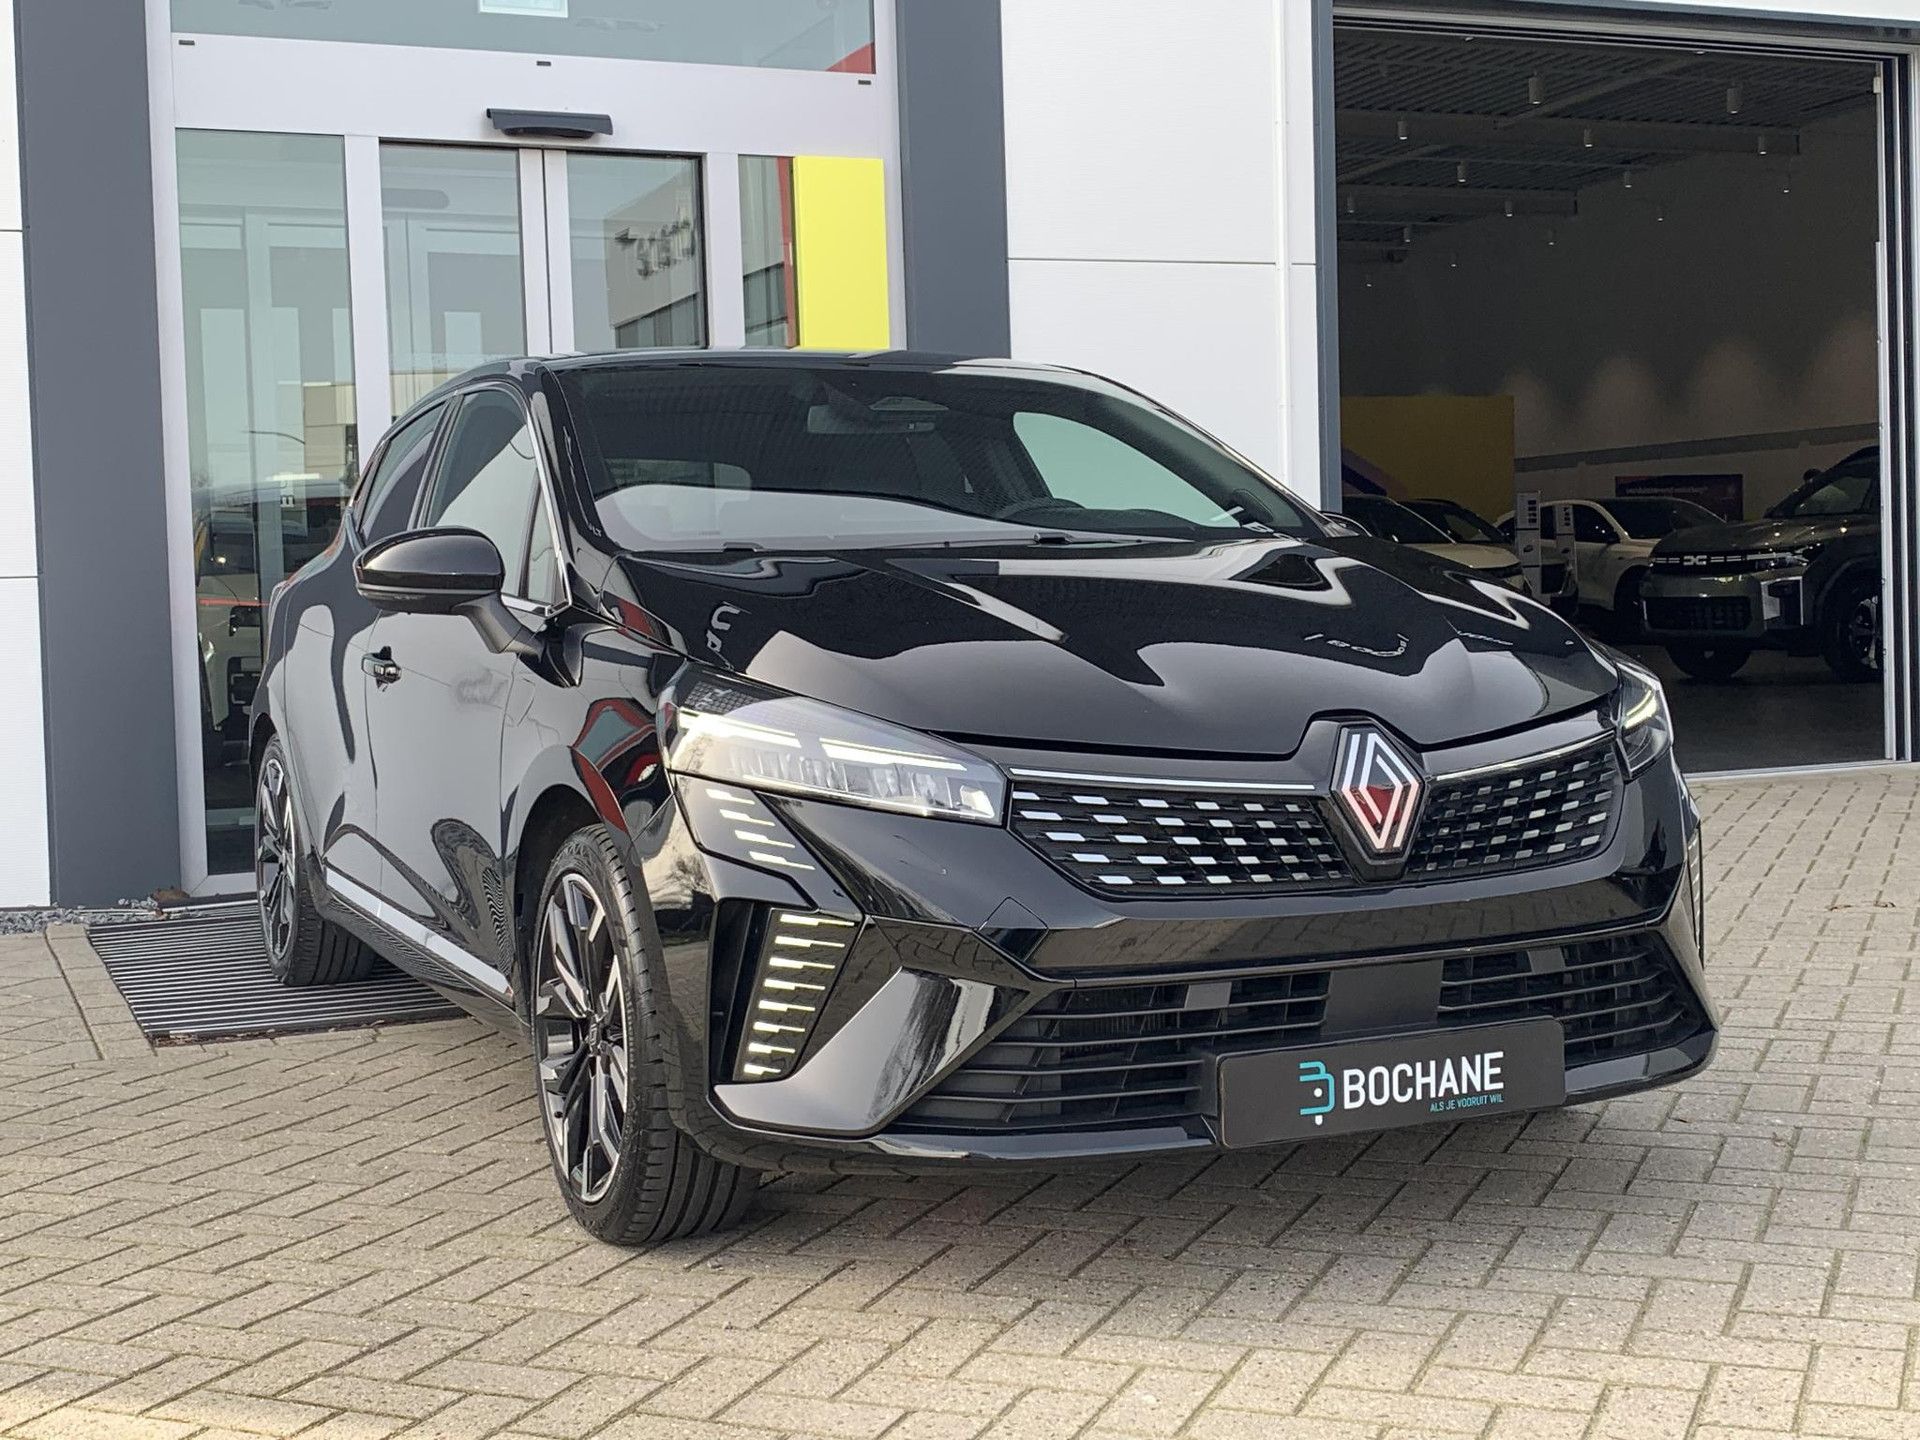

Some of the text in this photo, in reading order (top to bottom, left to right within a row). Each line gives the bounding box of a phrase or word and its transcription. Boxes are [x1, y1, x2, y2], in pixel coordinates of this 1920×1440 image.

[1343, 1051, 1504, 1110] BOCHANE
[1430, 1093, 1504, 1112] ALS JE VOORUIT WIL
